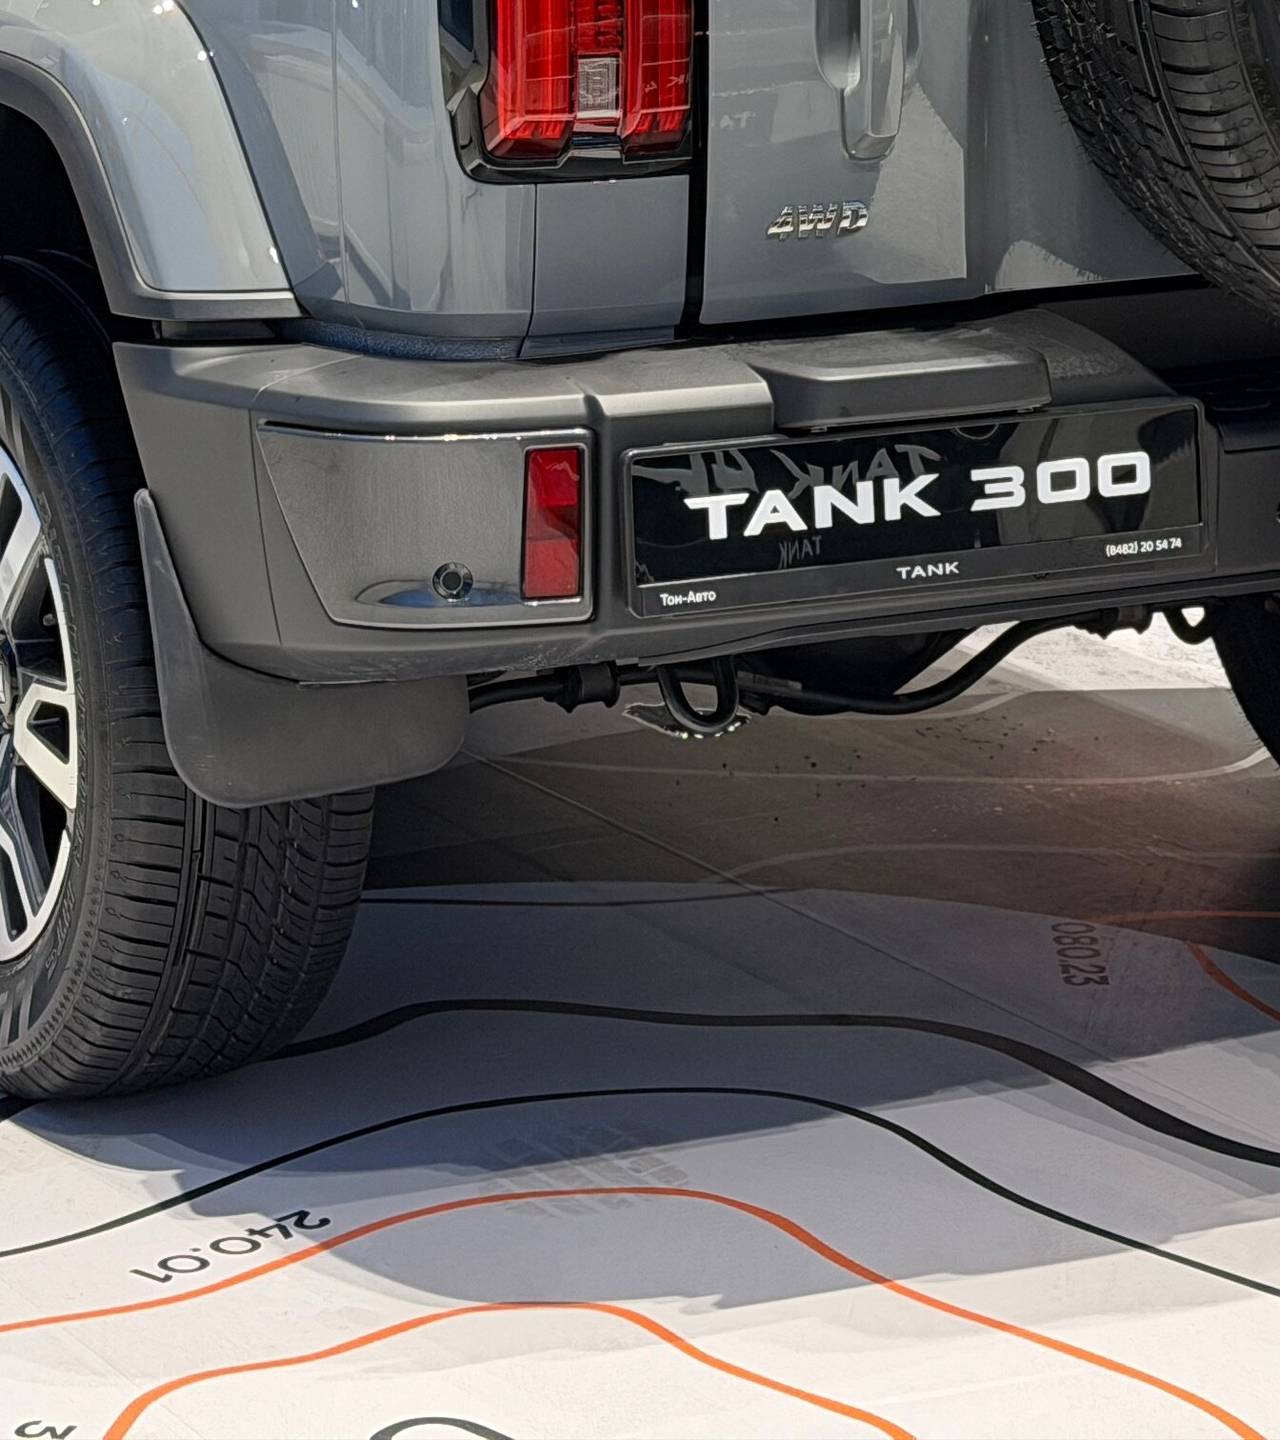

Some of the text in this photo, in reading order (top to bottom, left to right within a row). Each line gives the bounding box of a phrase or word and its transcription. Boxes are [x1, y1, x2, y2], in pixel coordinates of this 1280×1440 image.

[767, 200, 869, 241] 4WD
[683, 451, 1151, 540] TANK 300
[1140, 540, 1154, 553] 20
[1155, 539, 1169, 551] 54
[1169, 537, 1182, 550] 74
[896, 561, 960, 580] TANK
[129, 1210, 331, 1283] 240.01
